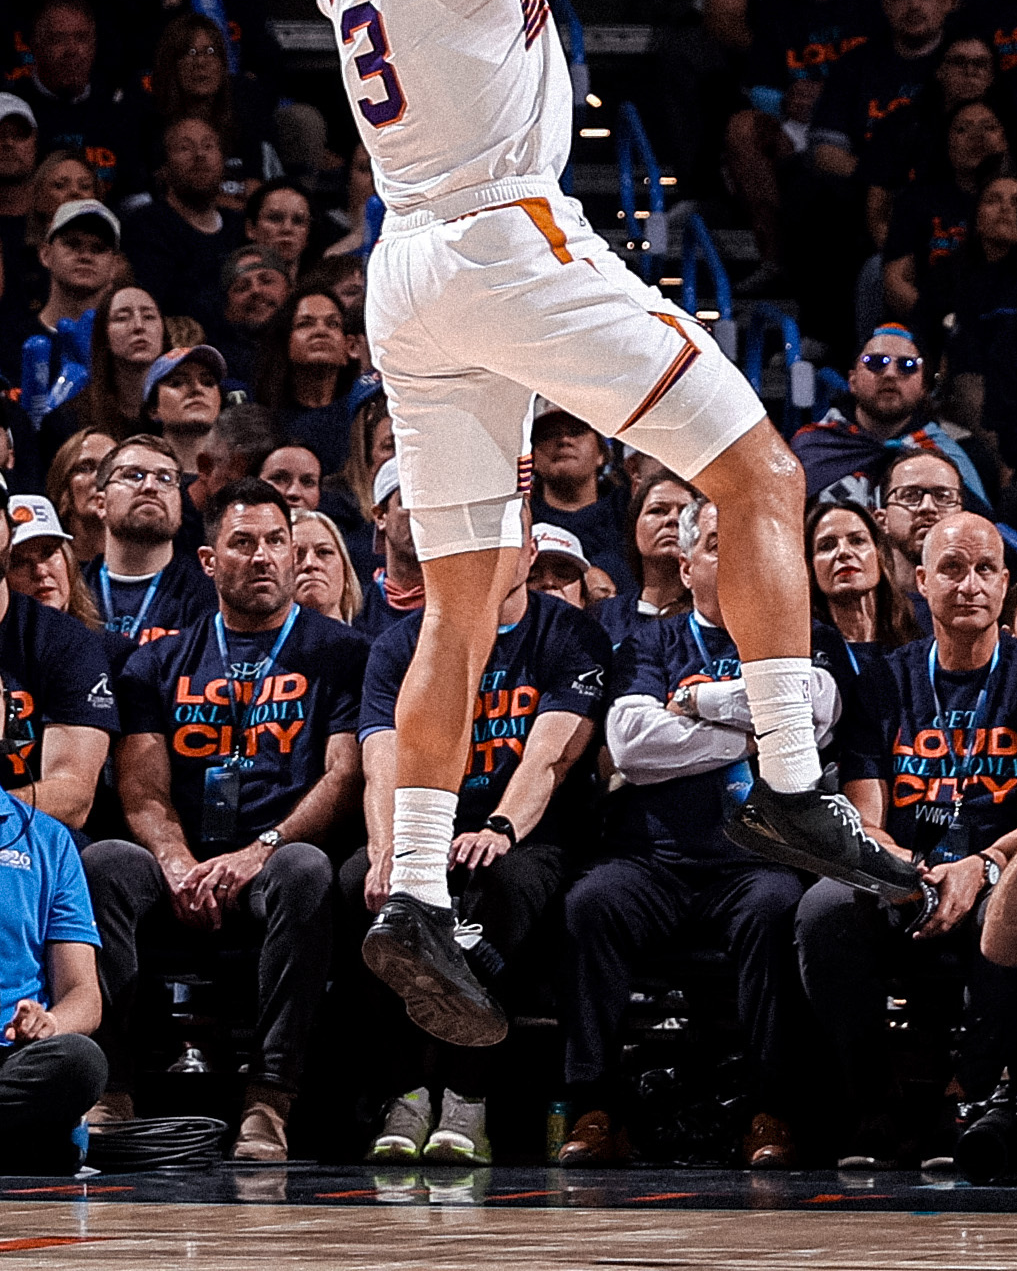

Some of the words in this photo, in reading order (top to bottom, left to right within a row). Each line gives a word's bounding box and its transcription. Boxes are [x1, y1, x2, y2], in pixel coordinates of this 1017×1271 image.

[340, 1, 407, 129] 3
[174, 672, 310, 706] LOUD
[480, 668, 508, 692] ET
[172, 720, 306, 758] CITY
